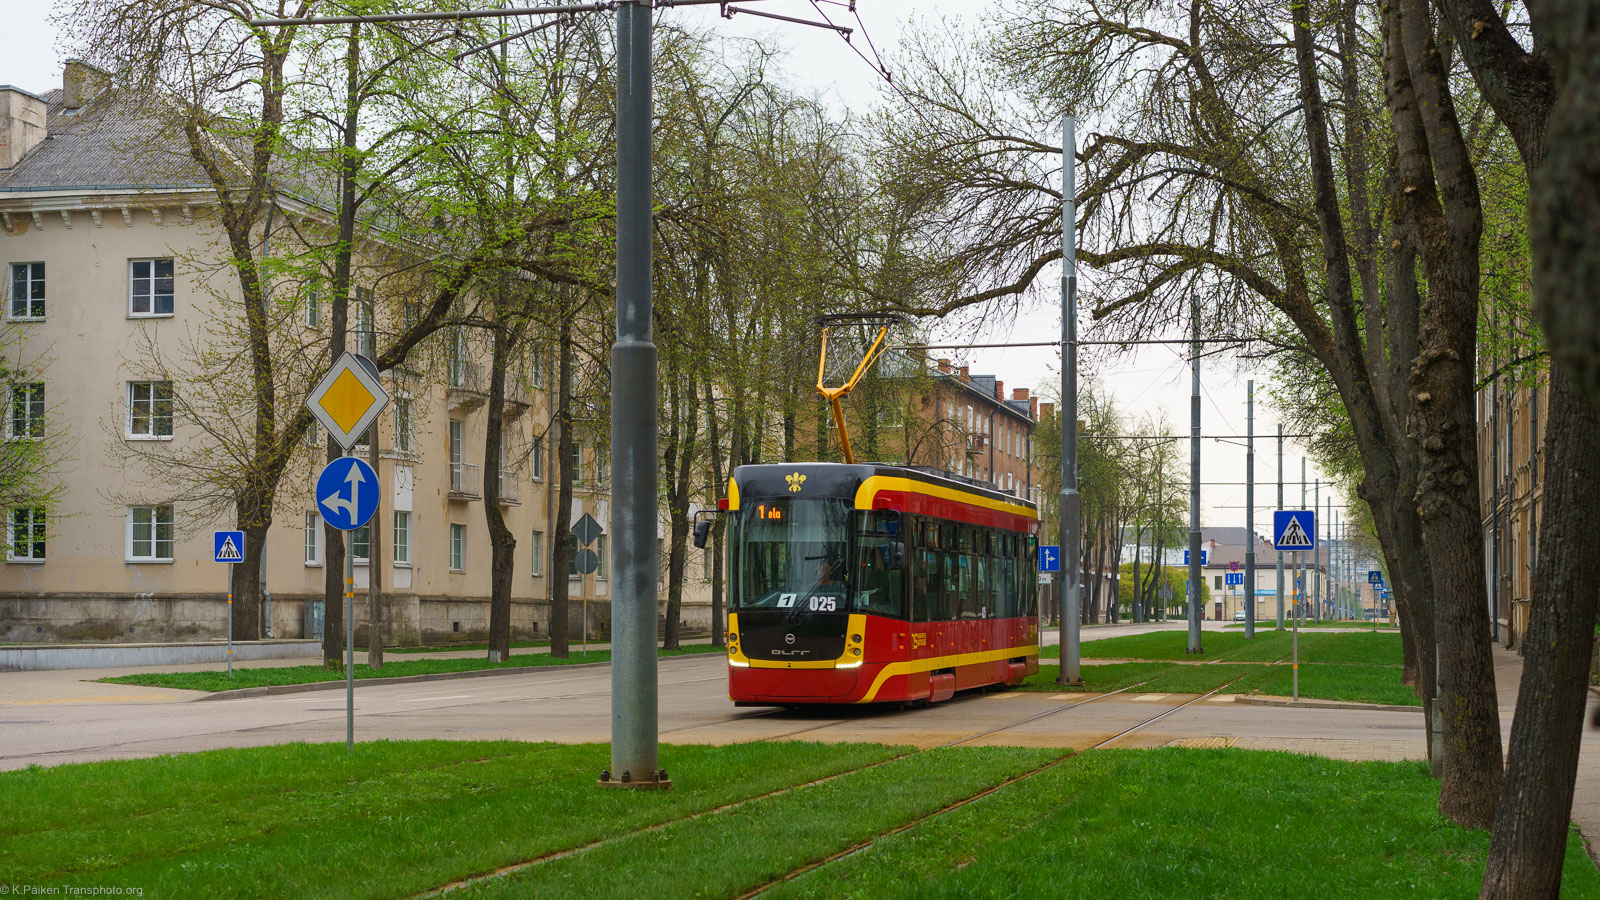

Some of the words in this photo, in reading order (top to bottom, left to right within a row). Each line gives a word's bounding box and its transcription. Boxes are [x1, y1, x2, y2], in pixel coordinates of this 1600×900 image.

[758, 504, 765, 519] 1
[782, 595, 792, 606] 1
[809, 596, 836, 612] 025
